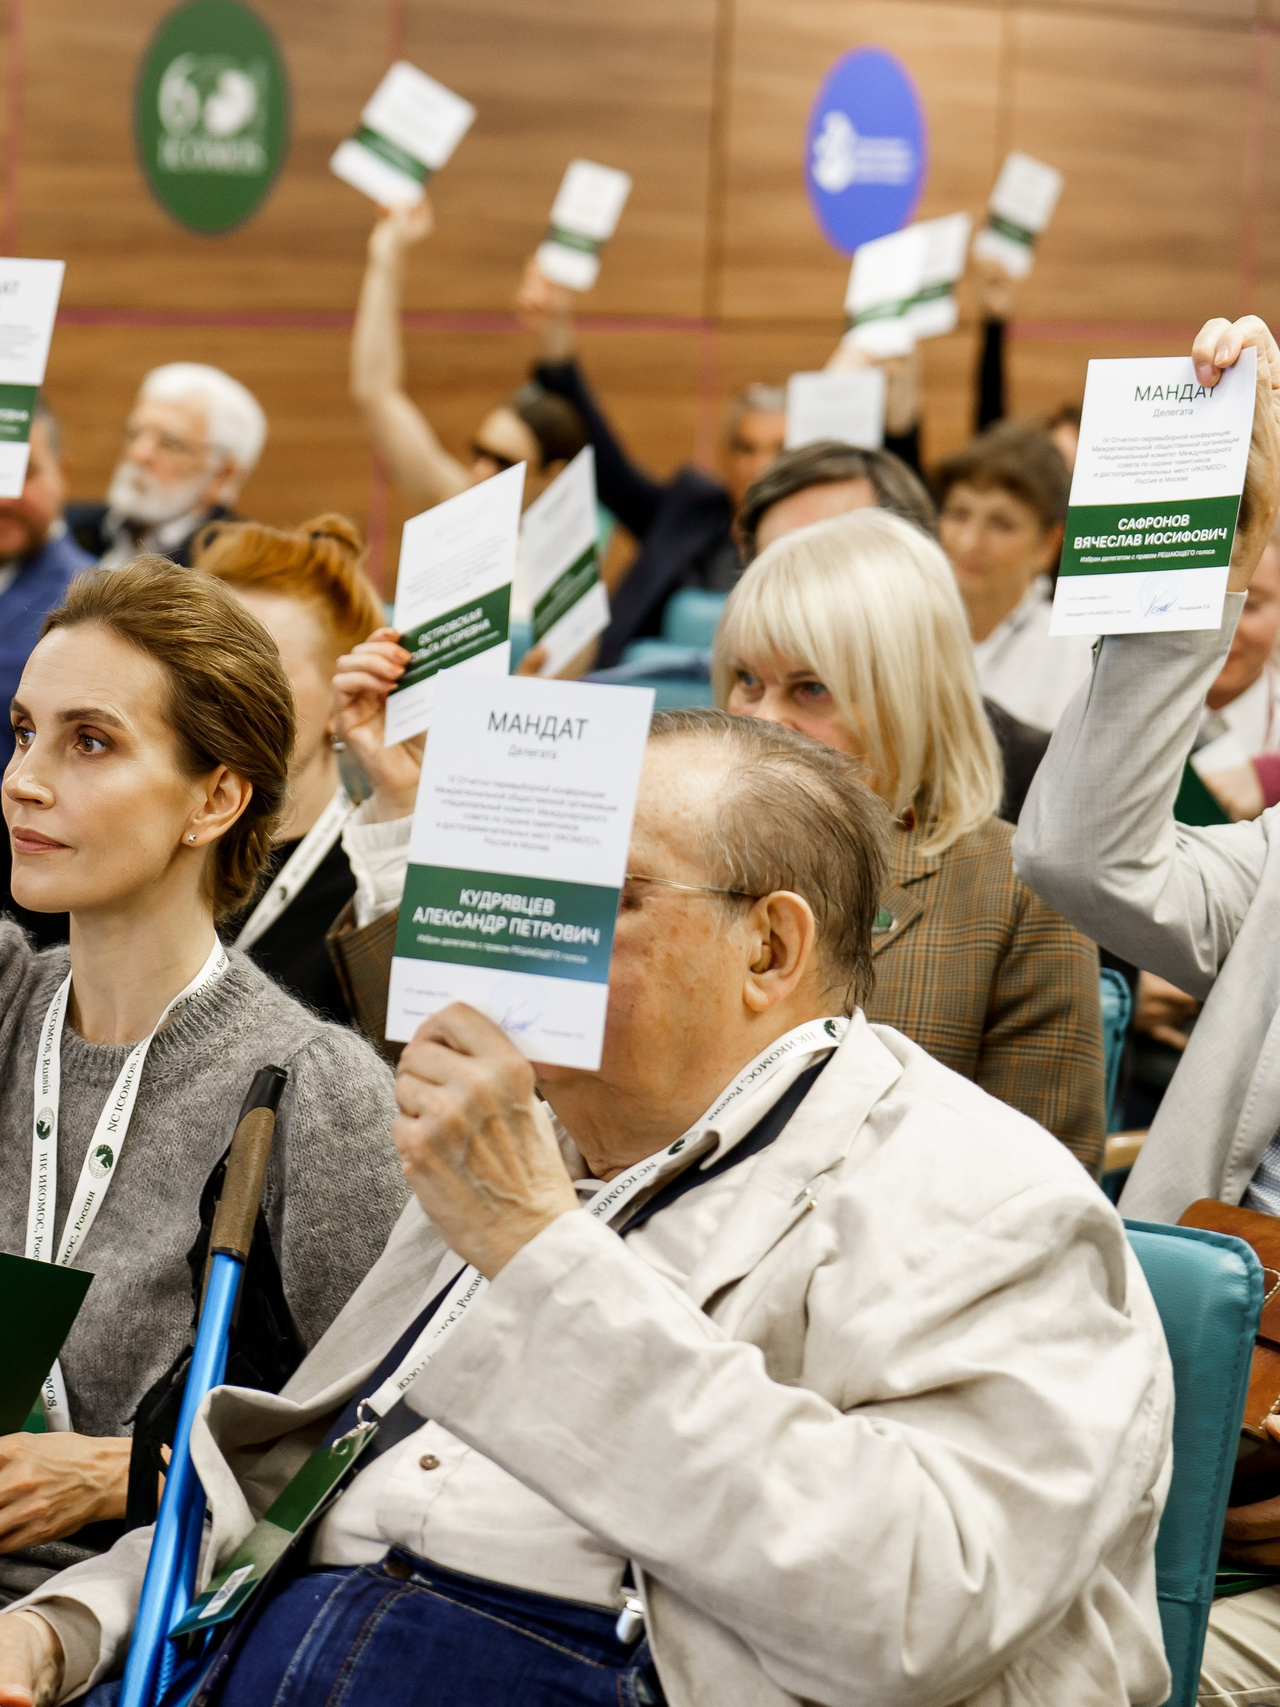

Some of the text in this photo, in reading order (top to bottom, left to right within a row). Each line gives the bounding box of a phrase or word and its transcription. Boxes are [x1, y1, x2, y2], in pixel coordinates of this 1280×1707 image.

[1152, 408, 1194, 418] Делегата
[1073, 527, 1228, 549] ВЯЧЕСЛАВ ИОСИФОВИЧ
[1117, 514, 1190, 531] САФРОНОВ
[1080, 555, 1101, 563] Избран
[418, 606, 483, 646] ОСТРОВСКАЯ
[440, 617, 491, 649] ИГОРЕВНА
[487, 710, 589, 741] МАНДАТ
[507, 744, 557, 760] Делегата
[459, 888, 555, 917] КУДРЯВЦЕВ
[412, 906, 601, 946] АЛЕКСАНДР ПЕТРОВИЧ
[42, 1007, 59, 1057] ICOMOS,
[42, 1058, 51, 1096] Russia
[707, 1031, 817, 1121] НК ИКОМОС, Россия
[107, 1060, 139, 1133] NC ICOMOS,
[39, 1152, 48, 1171] НК
[637, 1161, 657, 1177] NC
[33, 1174, 48, 1233] ИКОМОС,
[74, 1190, 96, 1231] Россия
